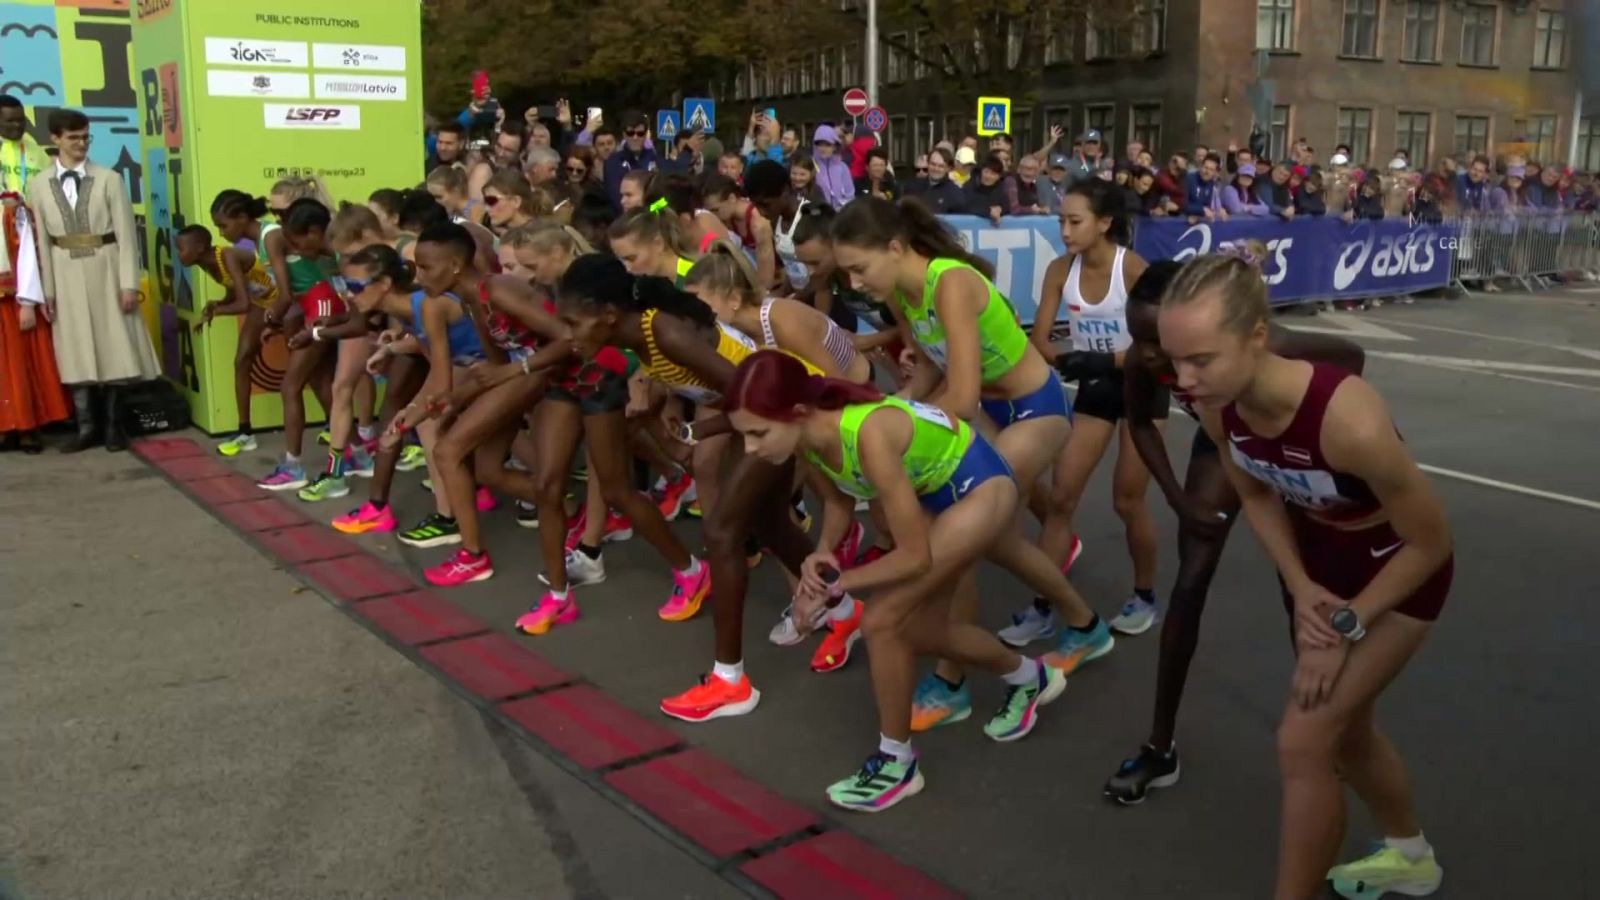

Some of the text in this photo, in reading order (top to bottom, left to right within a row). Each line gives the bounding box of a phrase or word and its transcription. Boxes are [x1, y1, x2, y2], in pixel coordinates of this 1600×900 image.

[256, 14, 360, 28] PUBLIC INSTITUTIONS
[363, 83, 397, 94] Latvia
[286, 107, 341, 121] LSFP
[1077, 320, 1120, 335] NTN
[1087, 338, 1115, 352] LEE
